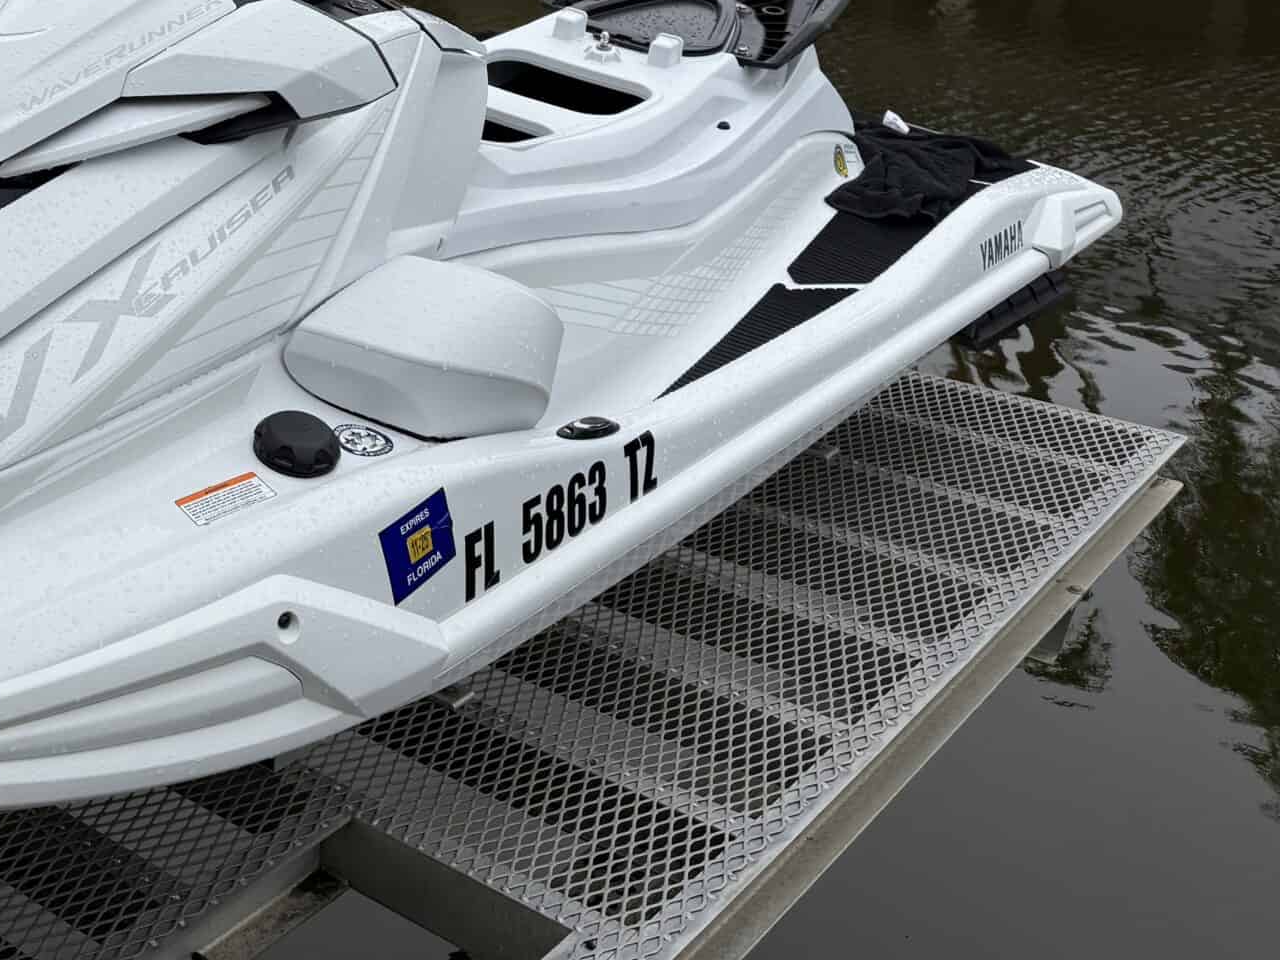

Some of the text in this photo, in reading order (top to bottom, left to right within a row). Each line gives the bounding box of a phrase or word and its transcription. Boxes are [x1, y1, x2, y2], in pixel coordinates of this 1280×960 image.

[132, 164, 297, 315] CRUISER
[980, 220, 1024, 272] YAMAHA
[400, 507, 430, 536] EXPIRES
[464, 429, 658, 603] FL 5863 TZ
[407, 551, 443, 587] FLORIDA
